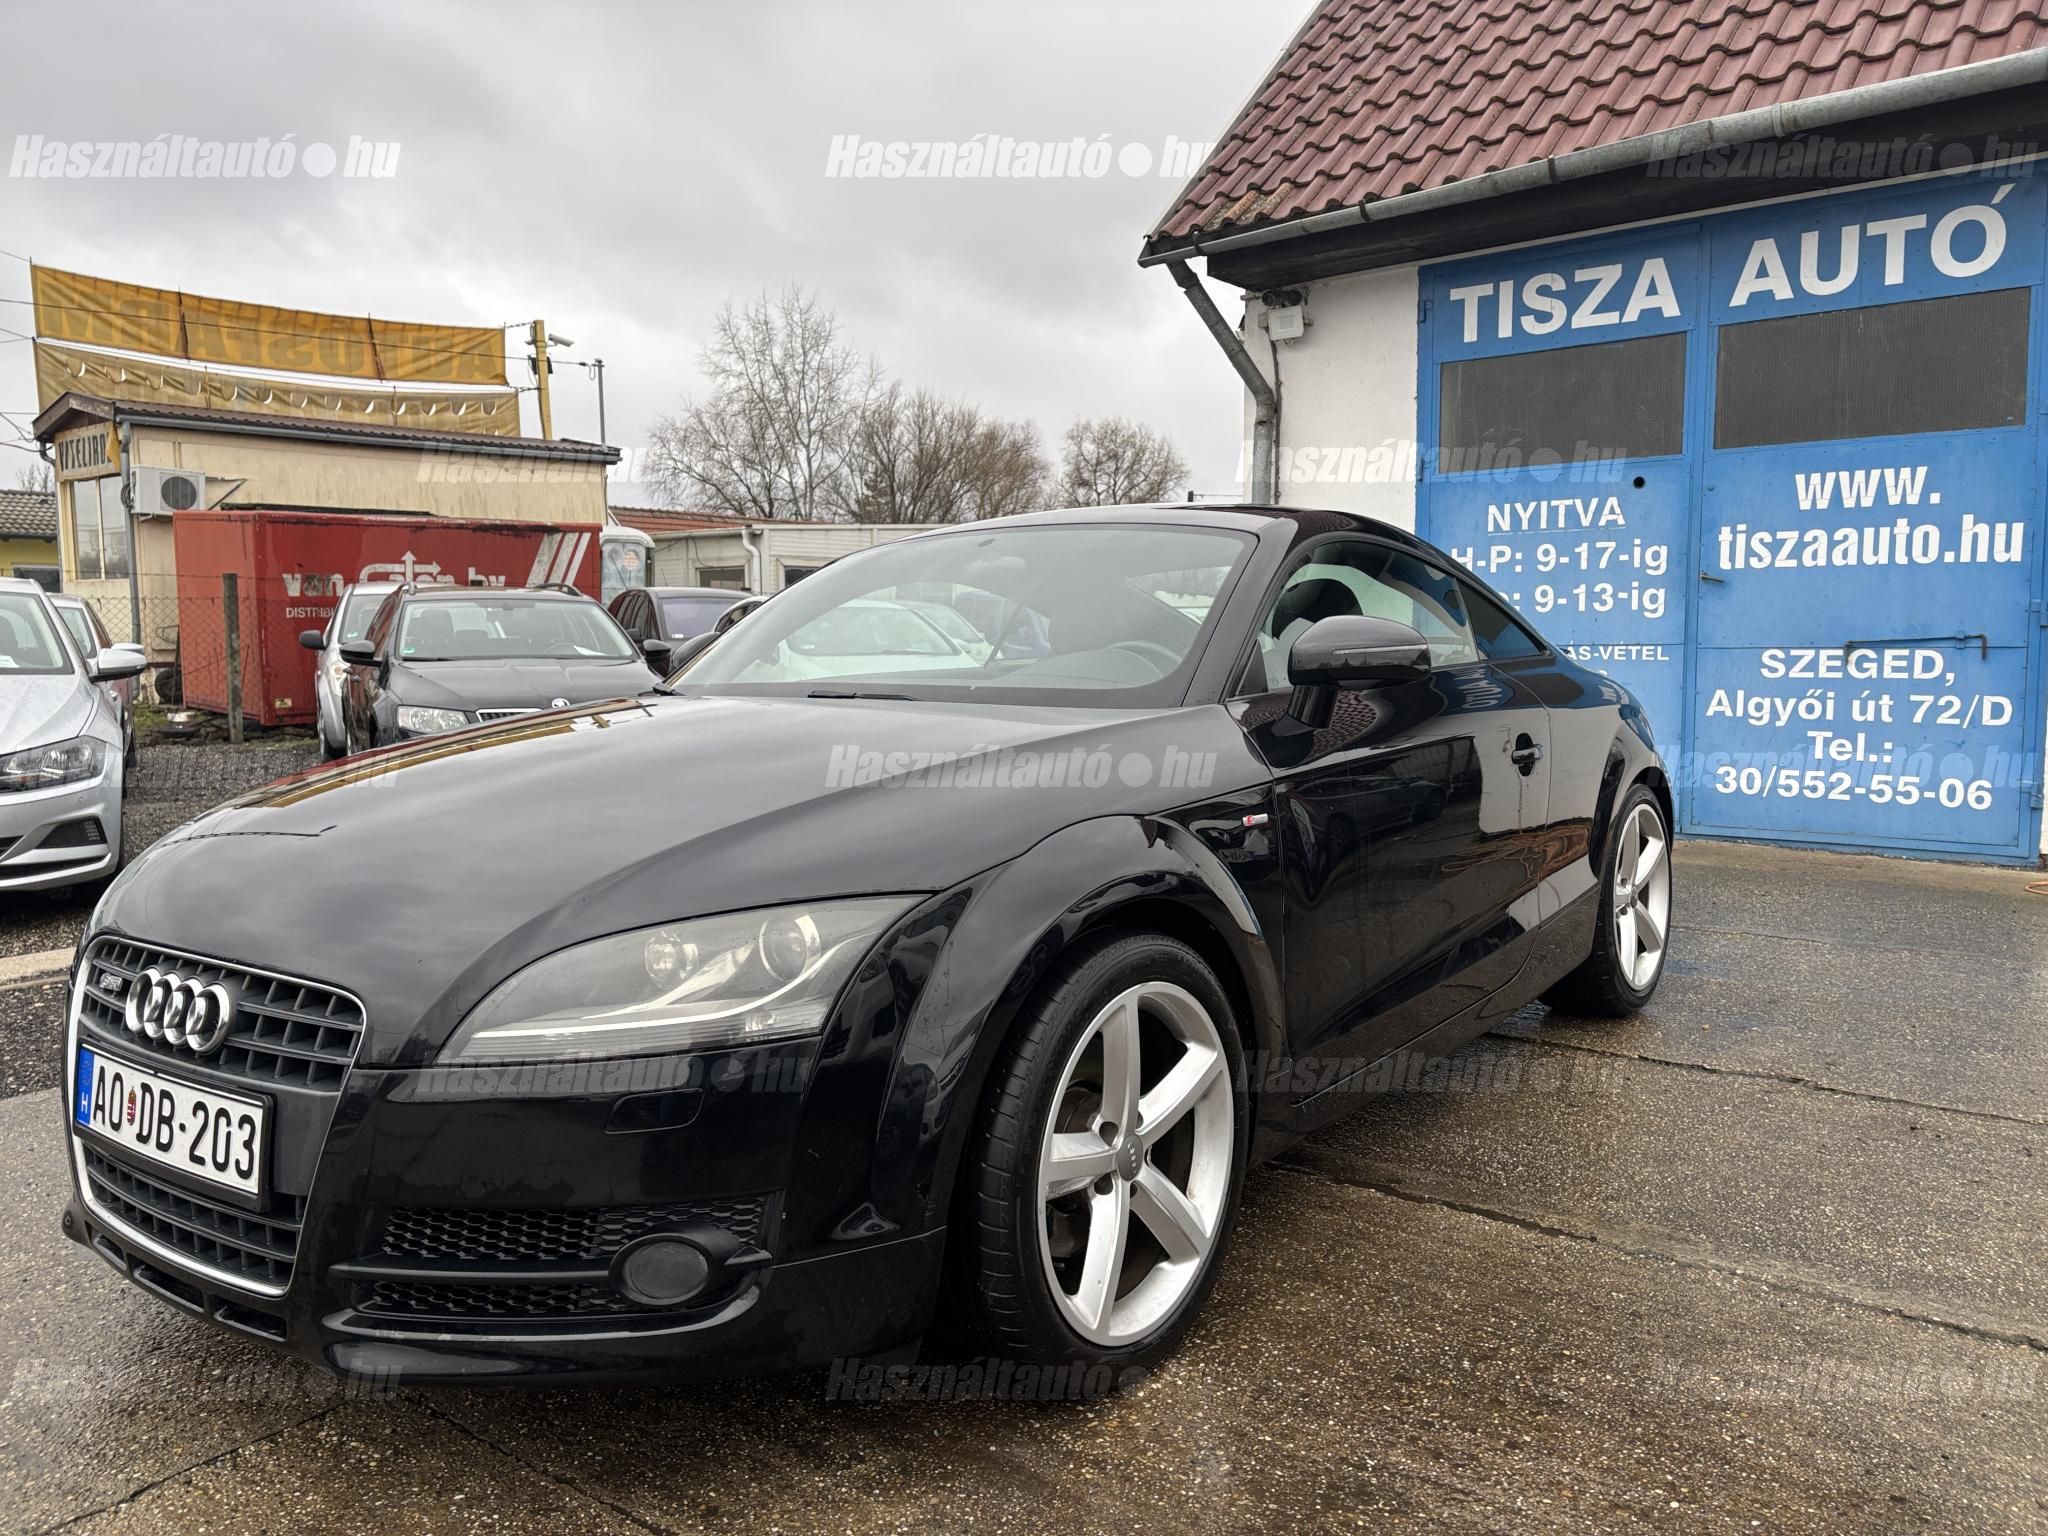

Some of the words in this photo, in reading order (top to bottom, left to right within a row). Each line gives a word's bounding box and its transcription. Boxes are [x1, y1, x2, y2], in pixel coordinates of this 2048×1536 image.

[1449, 257, 1680, 343] TISZA
[1729, 183, 2016, 307] AUTÓ
[1795, 466, 1941, 511] www.
[1487, 496, 1626, 533] NYITVA
[1452, 544, 1523, 574] H-P:
[1536, 539, 1668, 577] 9-17-ig
[1718, 514, 2025, 570] tiszaauto.hu
[282, 572, 344, 597] van
[1534, 581, 1666, 619] 9-13-ig
[1760, 648, 1956, 687] SZEGED,
[1706, 688, 1835, 727] Algyői
[1850, 687, 1892, 724] út
[1909, 692, 2014, 728] 72/D
[1806, 730, 1892, 763] Tel.:
[1715, 766, 1992, 811] 30/552-55-06
